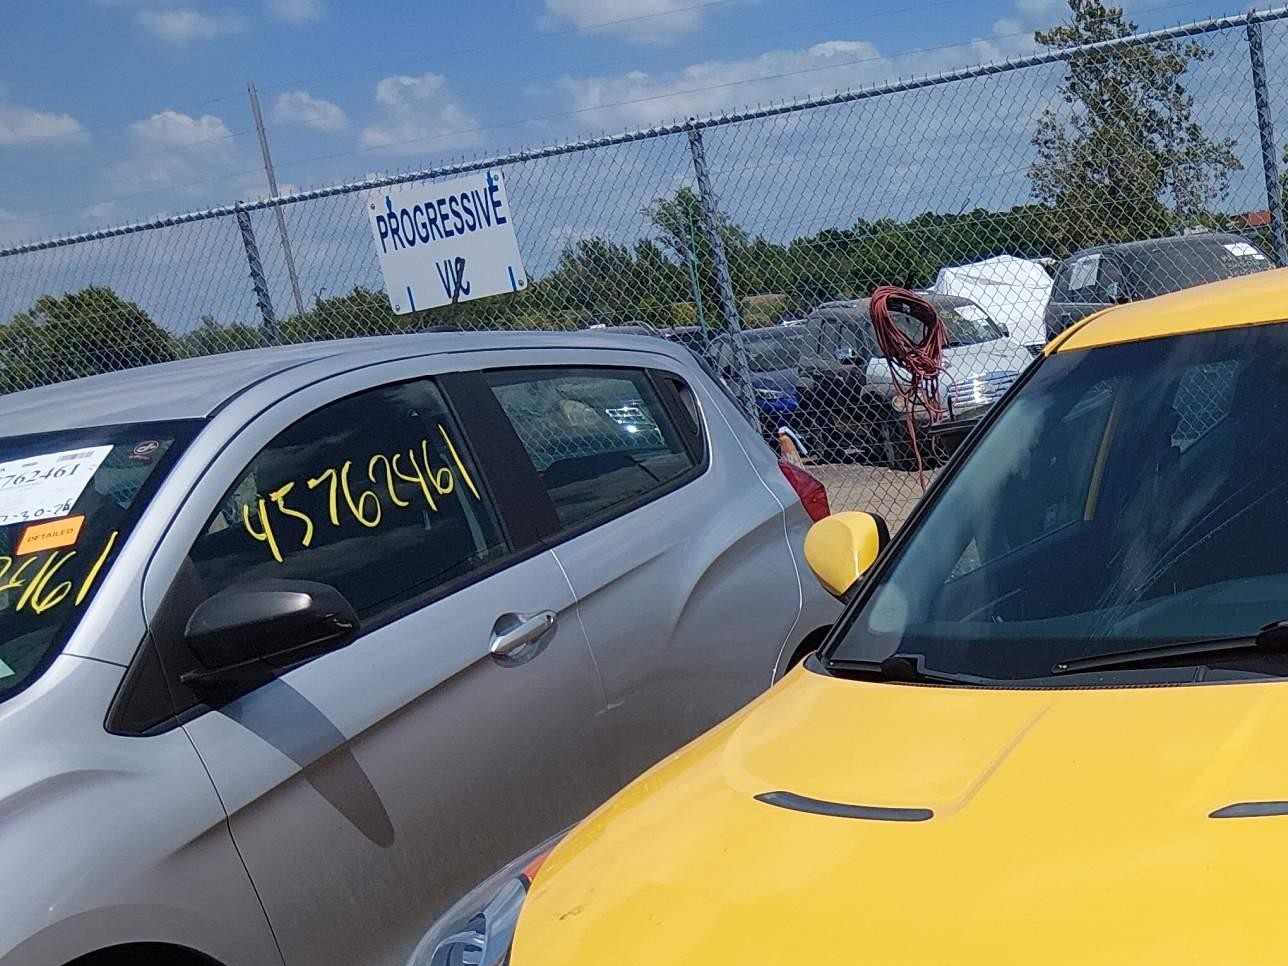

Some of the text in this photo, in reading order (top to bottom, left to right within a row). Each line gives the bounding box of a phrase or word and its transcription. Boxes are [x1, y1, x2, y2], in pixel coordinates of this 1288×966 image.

[376, 185, 507, 253] PROGRESSIVE
[0, 464, 80, 488] 762461
[243, 424, 480, 563] 45762461
[27, 528, 73, 542] DETAILED
